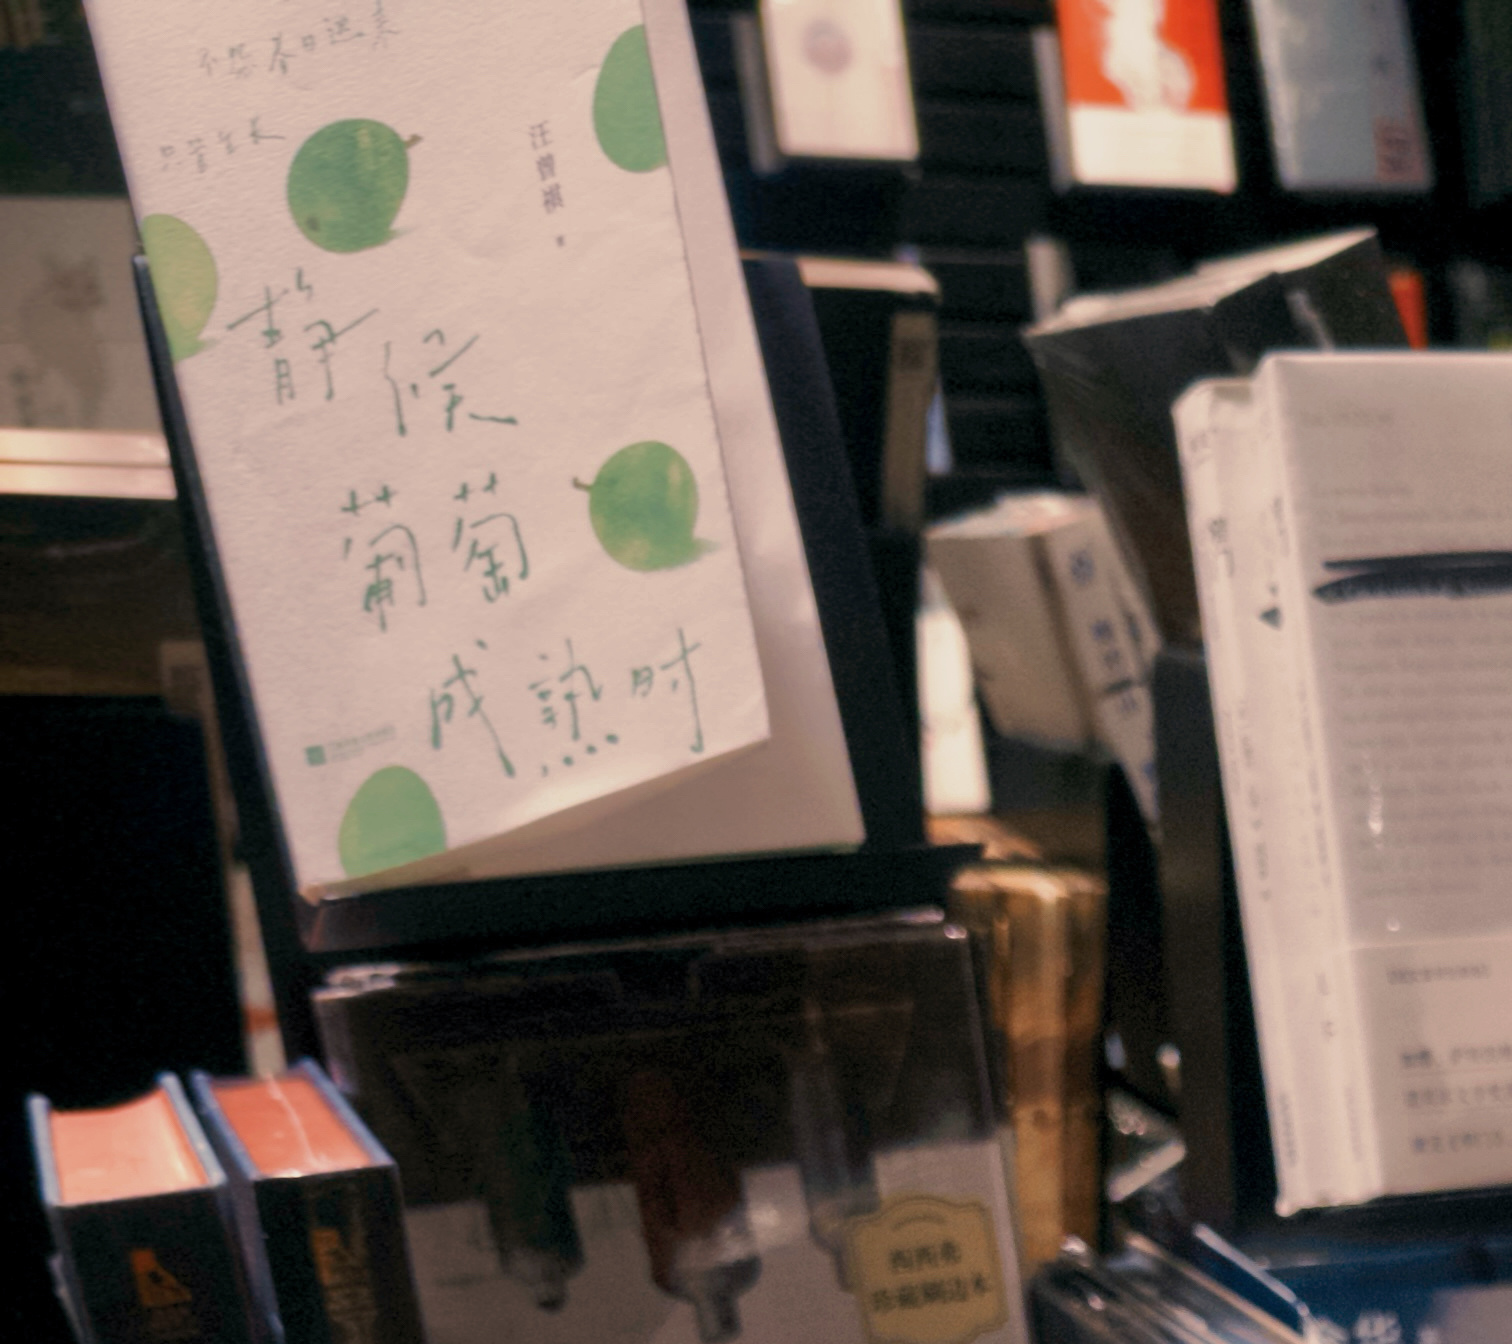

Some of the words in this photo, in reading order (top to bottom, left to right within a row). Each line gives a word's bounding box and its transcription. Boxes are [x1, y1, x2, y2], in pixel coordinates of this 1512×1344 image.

[226, 267, 519, 437] 静候
[341, 471, 529, 632] 葡萄
[429, 627, 708, 779] 成熟时
